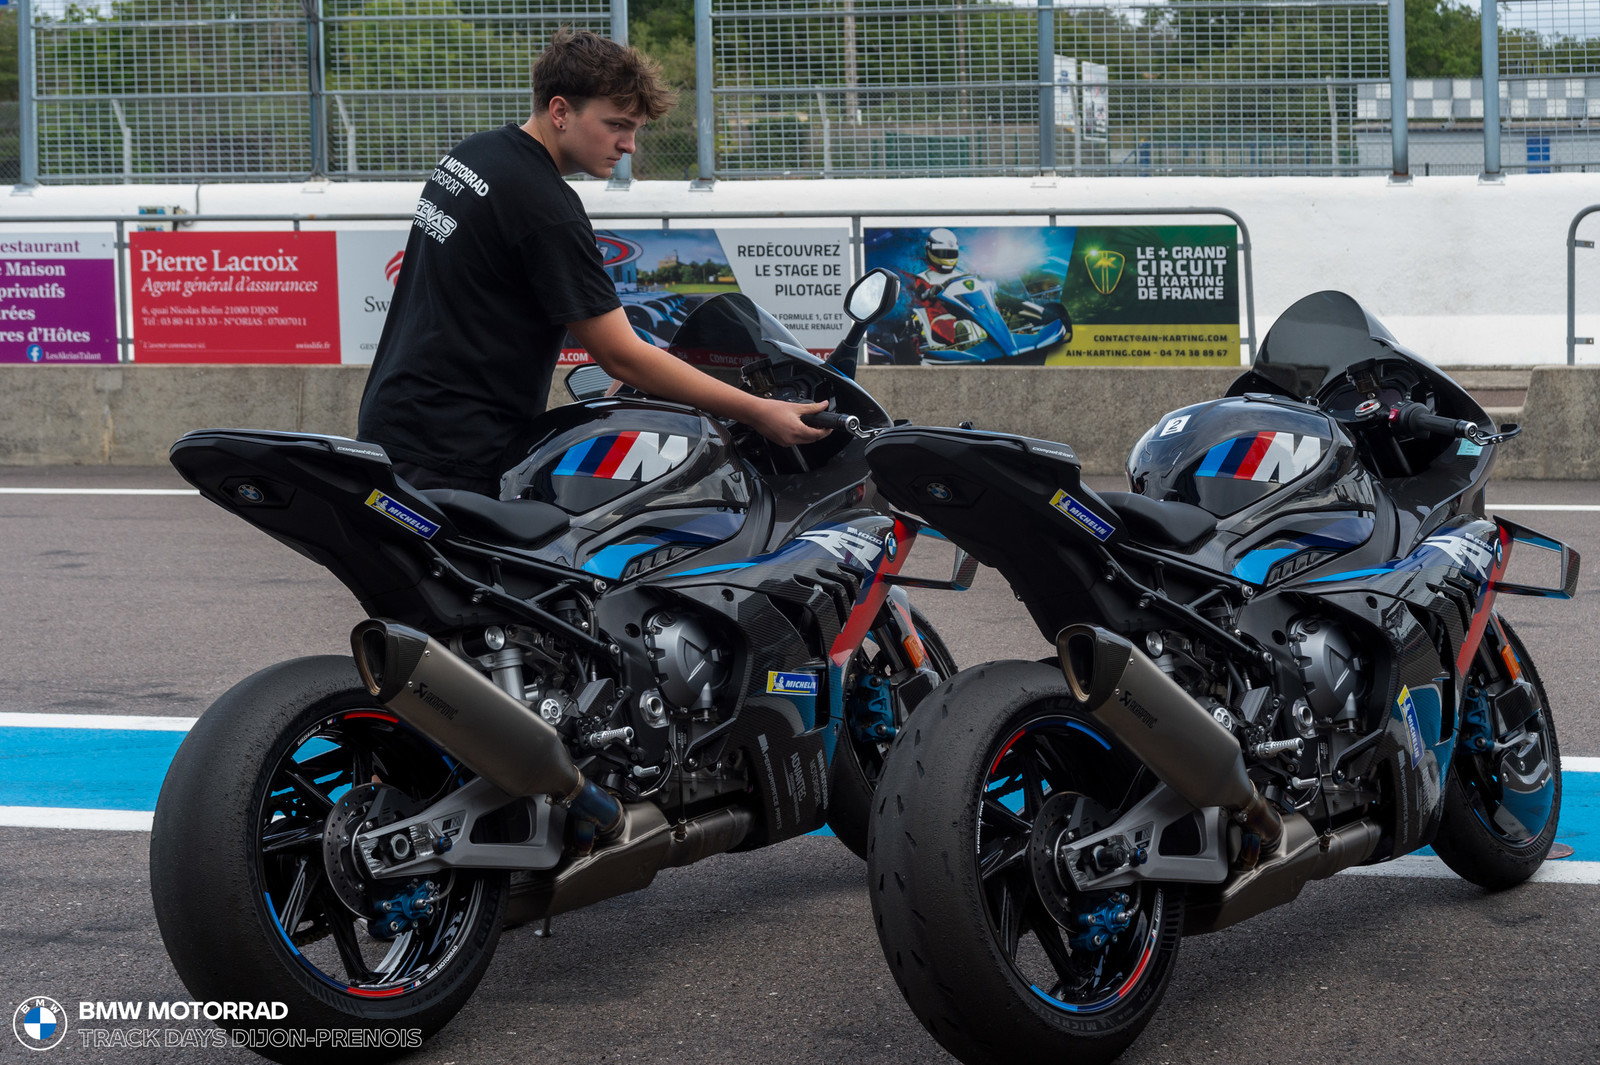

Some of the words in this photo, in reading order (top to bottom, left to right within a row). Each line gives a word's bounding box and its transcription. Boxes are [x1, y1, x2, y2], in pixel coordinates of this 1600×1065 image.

[431, 168, 465, 197] ORSPORT
[443, 156, 490, 197] MOTORRAD
[0, 240, 80, 254] estaurant
[737, 241, 841, 257] REDÉCOUVREZ
[1136, 246, 1155, 259] LE
[1171, 246, 1227, 259] GRAND
[140, 249, 208, 272] Pierre
[211, 249, 299, 272] Lacroix
[1137, 260, 1227, 275] CIRCUIT
[5, 261, 66, 277] Maison
[755, 264, 771, 277] LE
[774, 264, 819, 277] STAGE
[823, 264, 842, 277] DE
[141, 276, 181, 297] Agent
[181, 275, 233, 297] général
[1137, 276, 1155, 287] DE
[1160, 276, 1224, 287] KARTING
[775, 284, 842, 296] PILOTAGE
[1138, 287, 1158, 300] DE
[1162, 287, 1224, 300] FRANCE
[250, 306, 279, 316] DIJON
[364, 296, 391, 313] Sw
[0, 304, 36, 321] rées
[0, 330, 25, 343] res
[1093, 334, 1228, 342] CONTACT@AIN-KARTING.COM
[557, 351, 589, 363] A.COM
[1066, 349, 1151, 357] AIN-KARTING.COM
[1160, 349, 1172, 357] 04
[1175, 349, 1186, 357] 74
[1189, 349, 1200, 357] 38
[1202, 349, 1214, 357] 89
[1217, 349, 1228, 357] 67
[1168, 418, 1183, 432] 2
[337, 446, 384, 457] competition
[1032, 446, 1075, 458] competition
[387, 506, 431, 533] MICHELIN
[1069, 505, 1107, 535] MICHELIN
[785, 680, 817, 690] MICHELIN
[1406, 715, 1420, 759] MICHELIN
[437, 945, 459, 971] MOTORRAD
